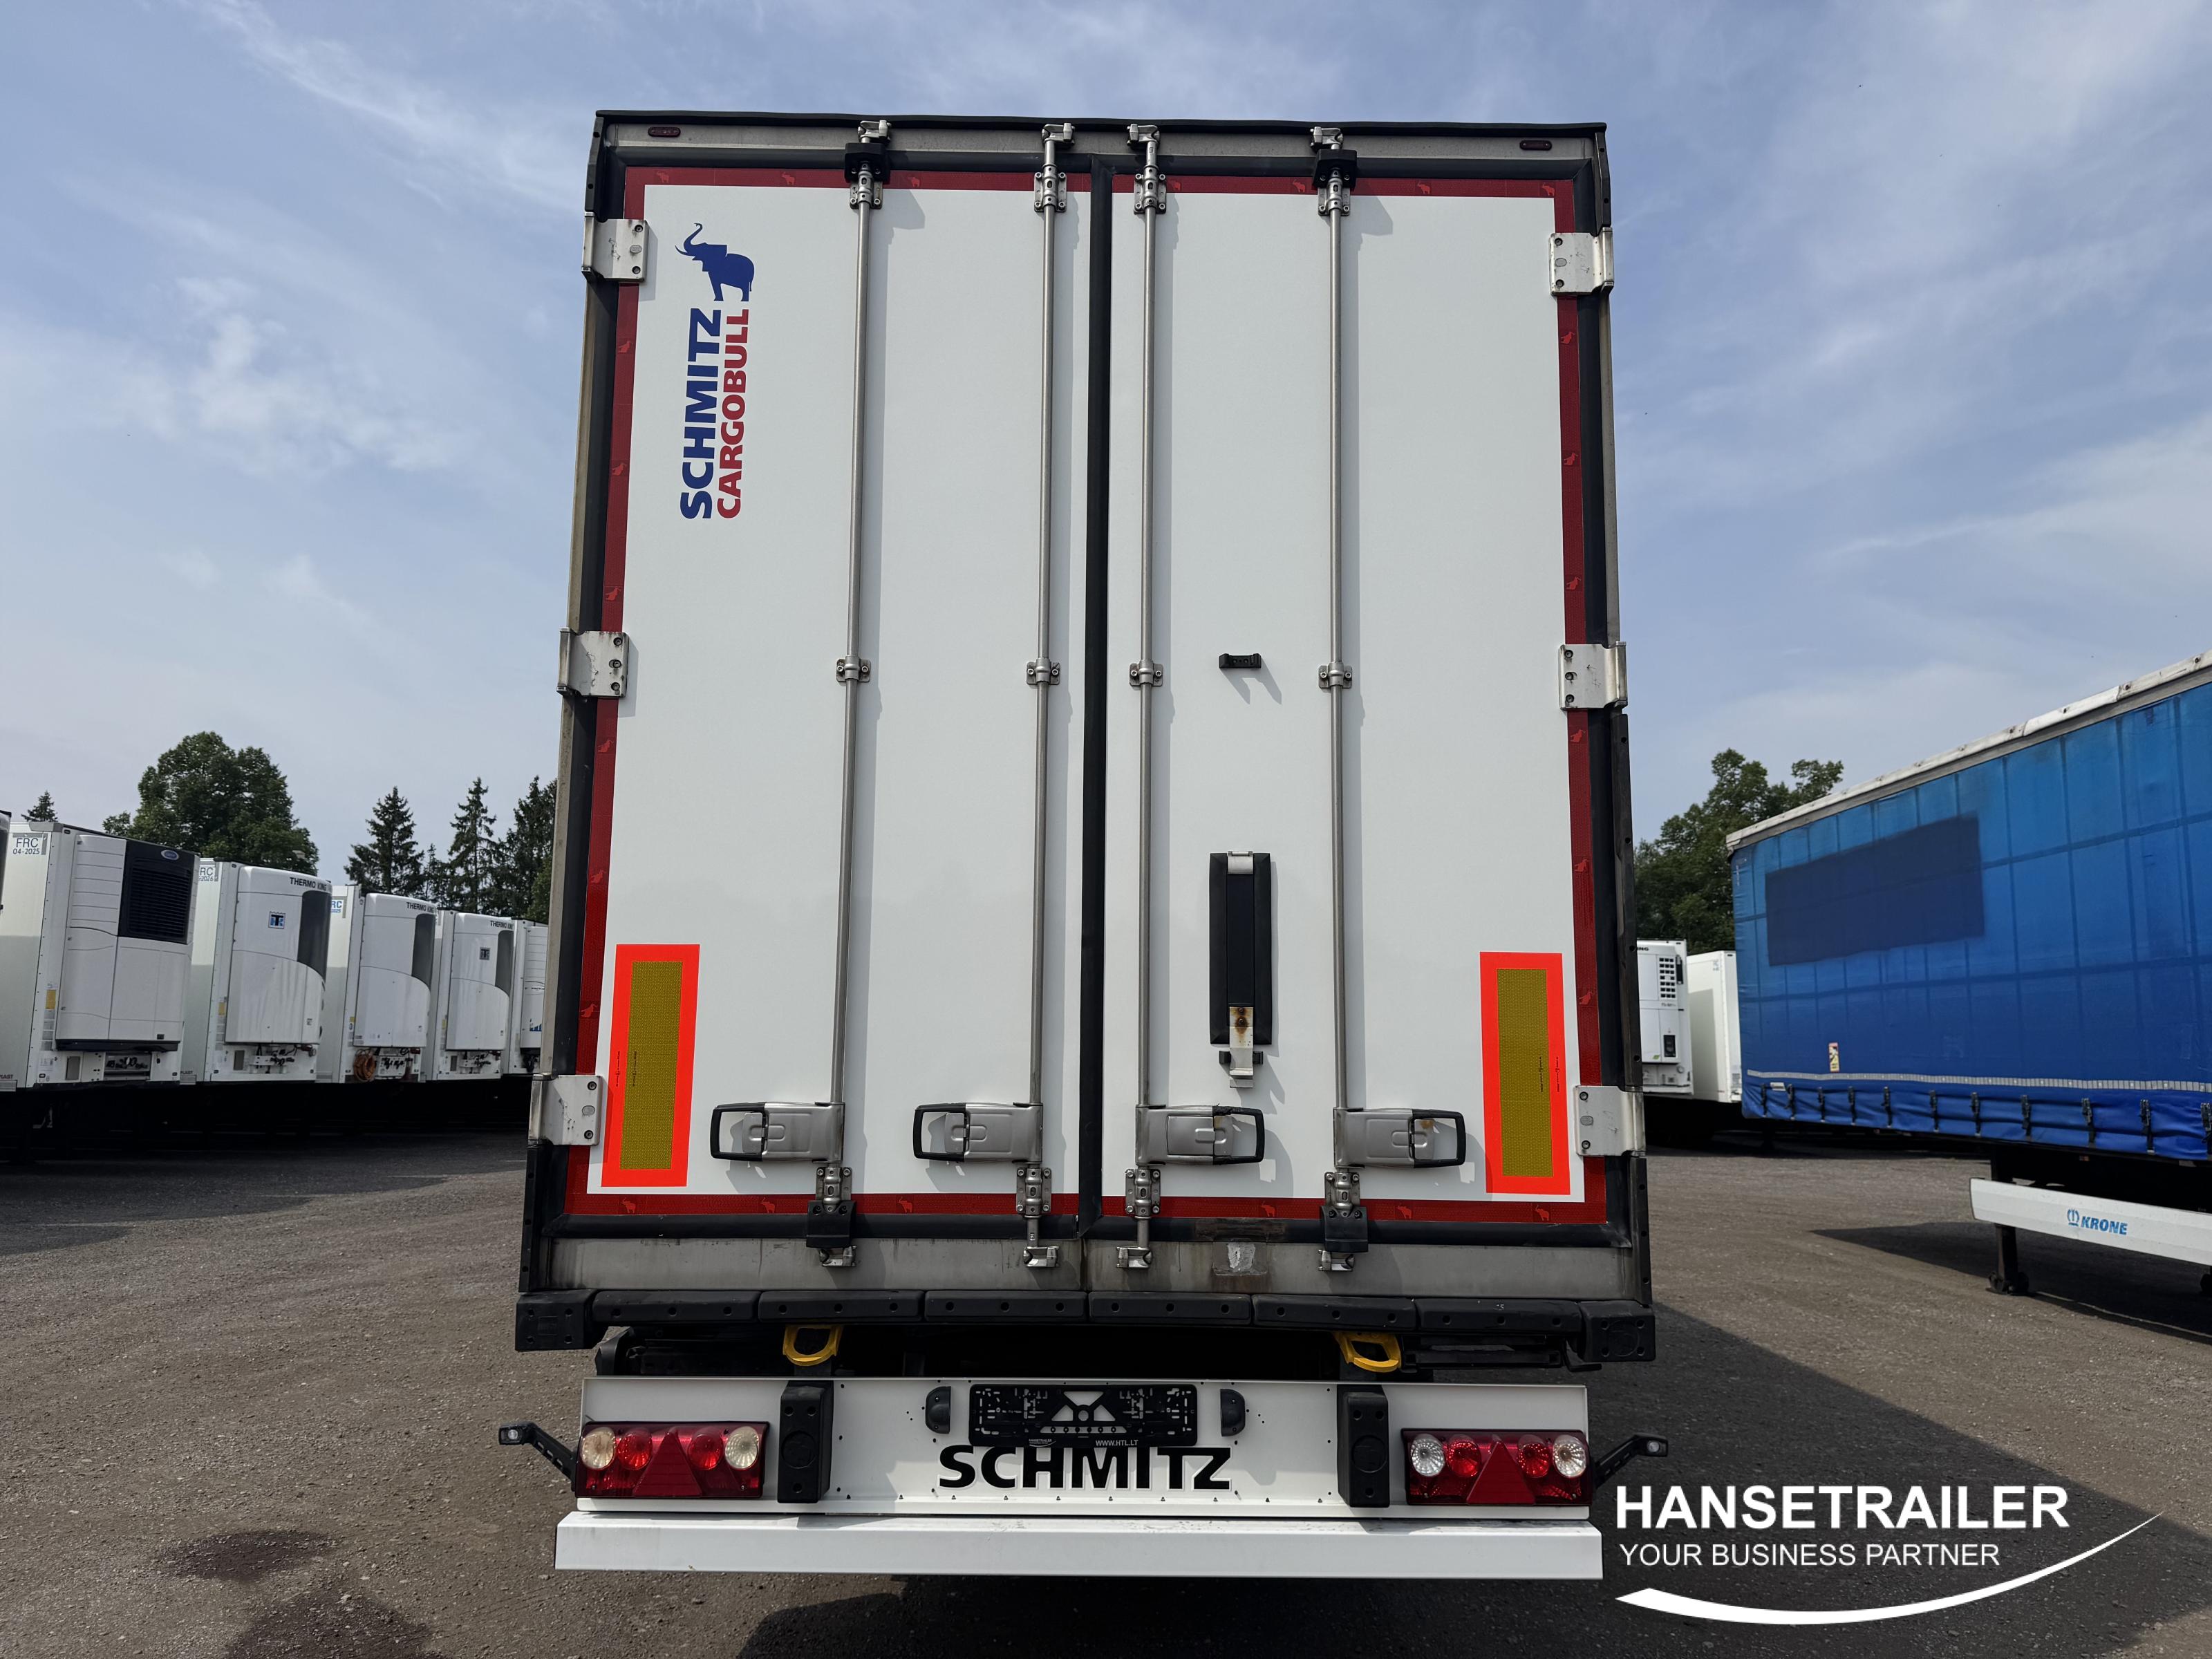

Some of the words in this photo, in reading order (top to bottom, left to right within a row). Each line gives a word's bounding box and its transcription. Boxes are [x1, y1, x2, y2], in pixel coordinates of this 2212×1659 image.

[681, 308, 721, 518] SCHMITZ
[717, 309, 749, 518] CARGOBULL
[17, 838, 39, 847] FRC
[200, 867, 213, 876] RC
[290, 877, 316, 888] THERMO
[406, 901, 427, 911] THERMO
[2081, 1216, 2128, 1236] KRONE
[939, 1444, 1232, 1490] SCHMITZ
